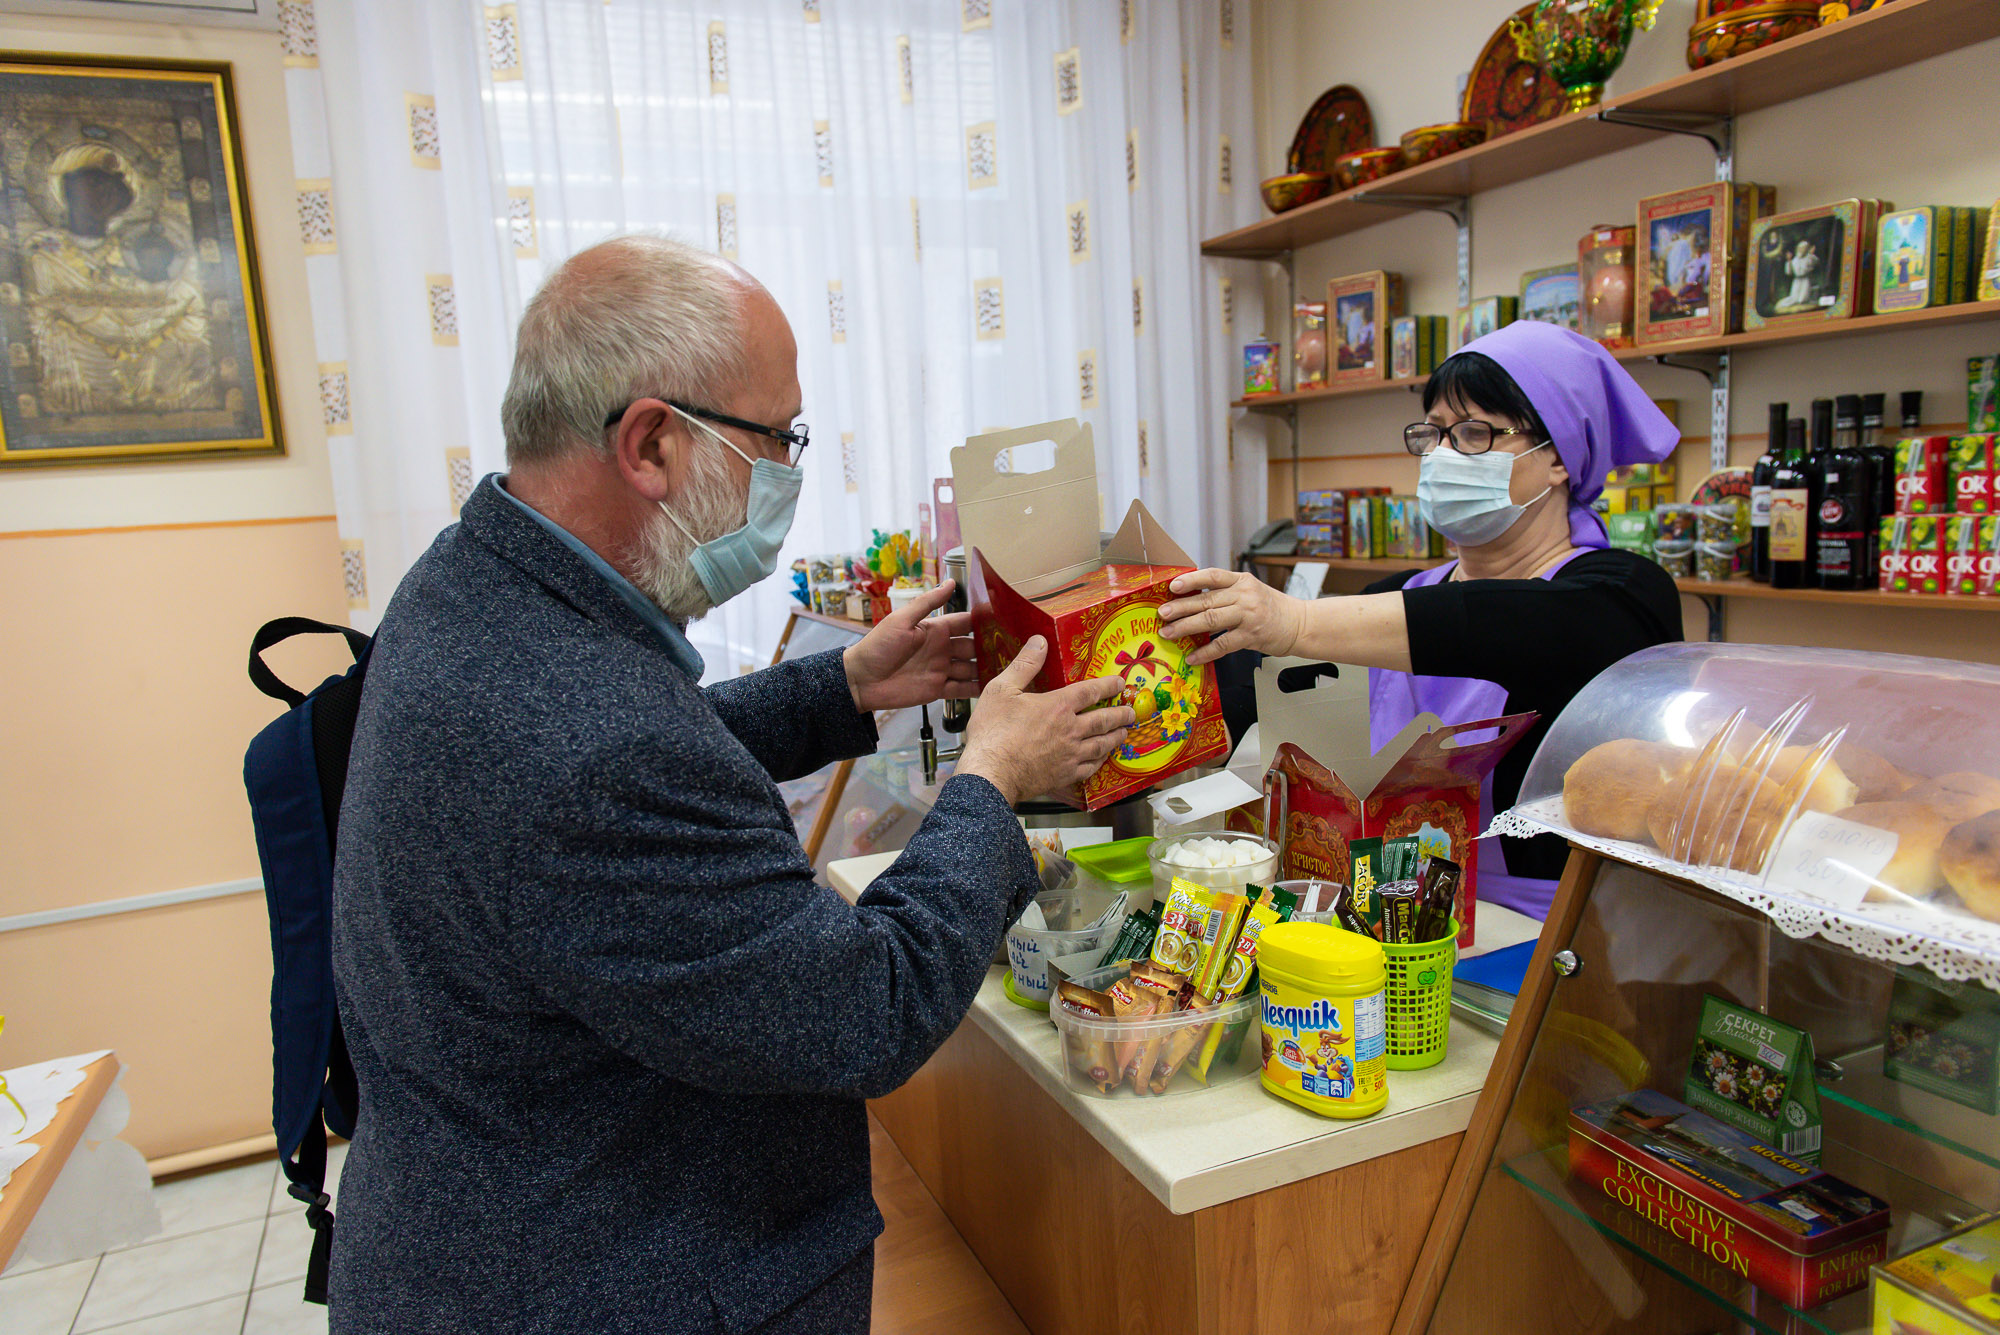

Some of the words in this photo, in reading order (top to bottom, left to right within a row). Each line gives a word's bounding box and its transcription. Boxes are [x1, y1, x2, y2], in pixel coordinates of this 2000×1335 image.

[1957, 475, 1988, 494] OK
[1910, 555, 1939, 573] OK
[1086, 627, 1126, 680] РИСТОС
[1357, 860, 1367, 908] JACOBS
[1384, 907, 1392, 943] Americano
[1261, 994, 1340, 1038] Nesquik
[1724, 1013, 1777, 1044] СЕКРЕТ
[1749, 1144, 1811, 1175] МОСКВА
[1616, 1158, 1736, 1245] EXCLUSIVE
[1602, 1176, 1751, 1279] COLLECTION
[1820, 1242, 1881, 1279] ENERGY
